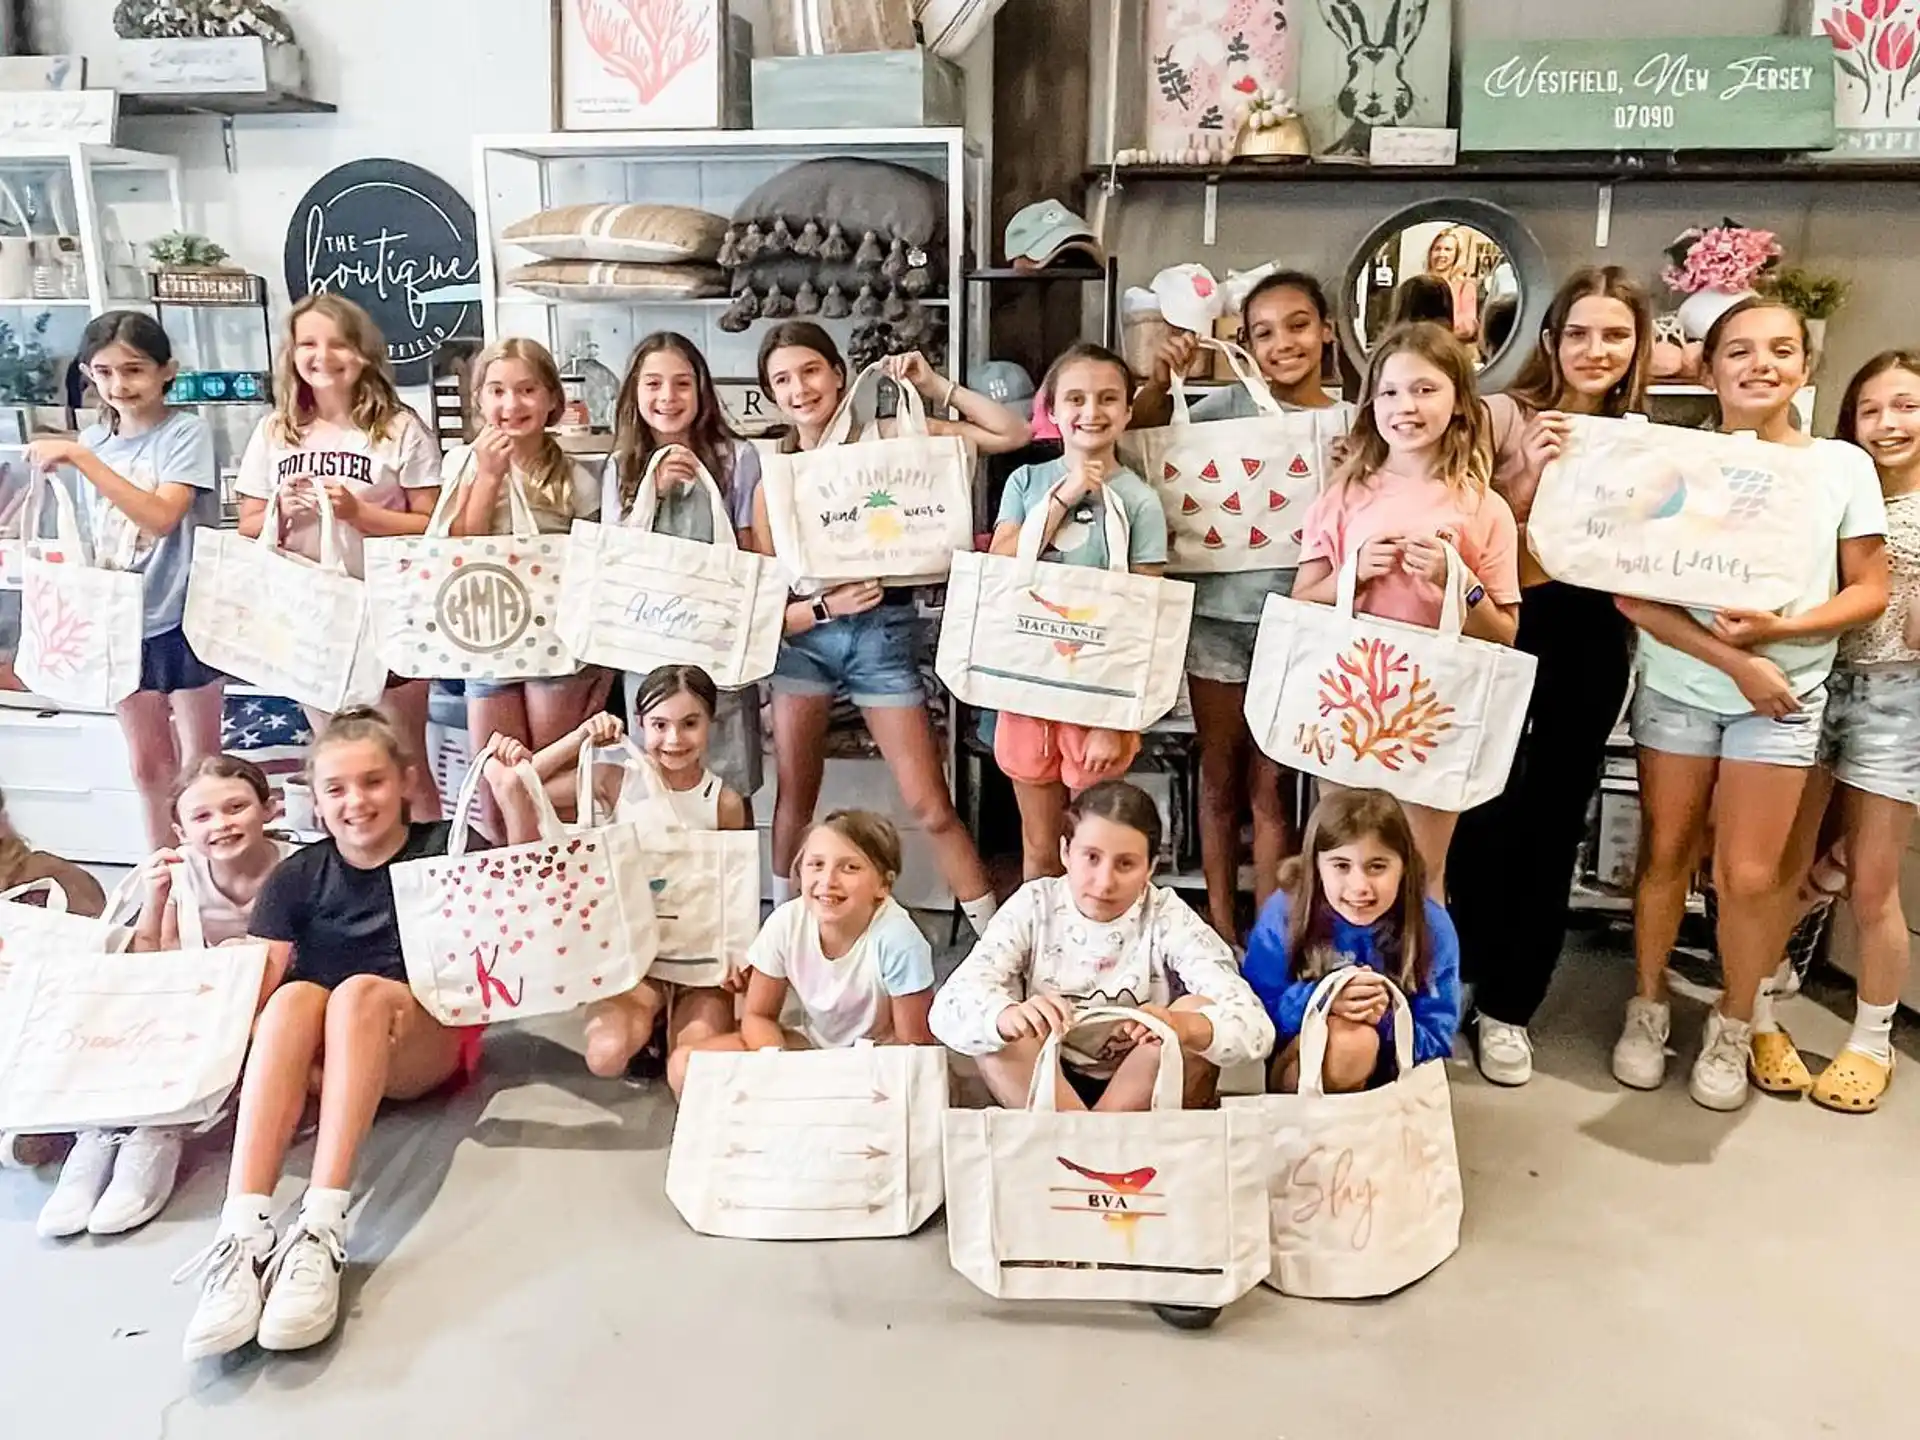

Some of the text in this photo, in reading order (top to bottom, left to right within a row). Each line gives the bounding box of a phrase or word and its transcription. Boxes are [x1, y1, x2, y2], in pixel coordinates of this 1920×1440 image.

[1614, 105, 1675, 129] 07090
[325, 235, 358, 251] THE
[306, 204, 479, 329] boutique
[743, 390, 764, 415] R
[446, 575, 520, 642] KMA
[469, 943, 524, 1009] K
[1088, 1194, 1128, 1209] BVA
